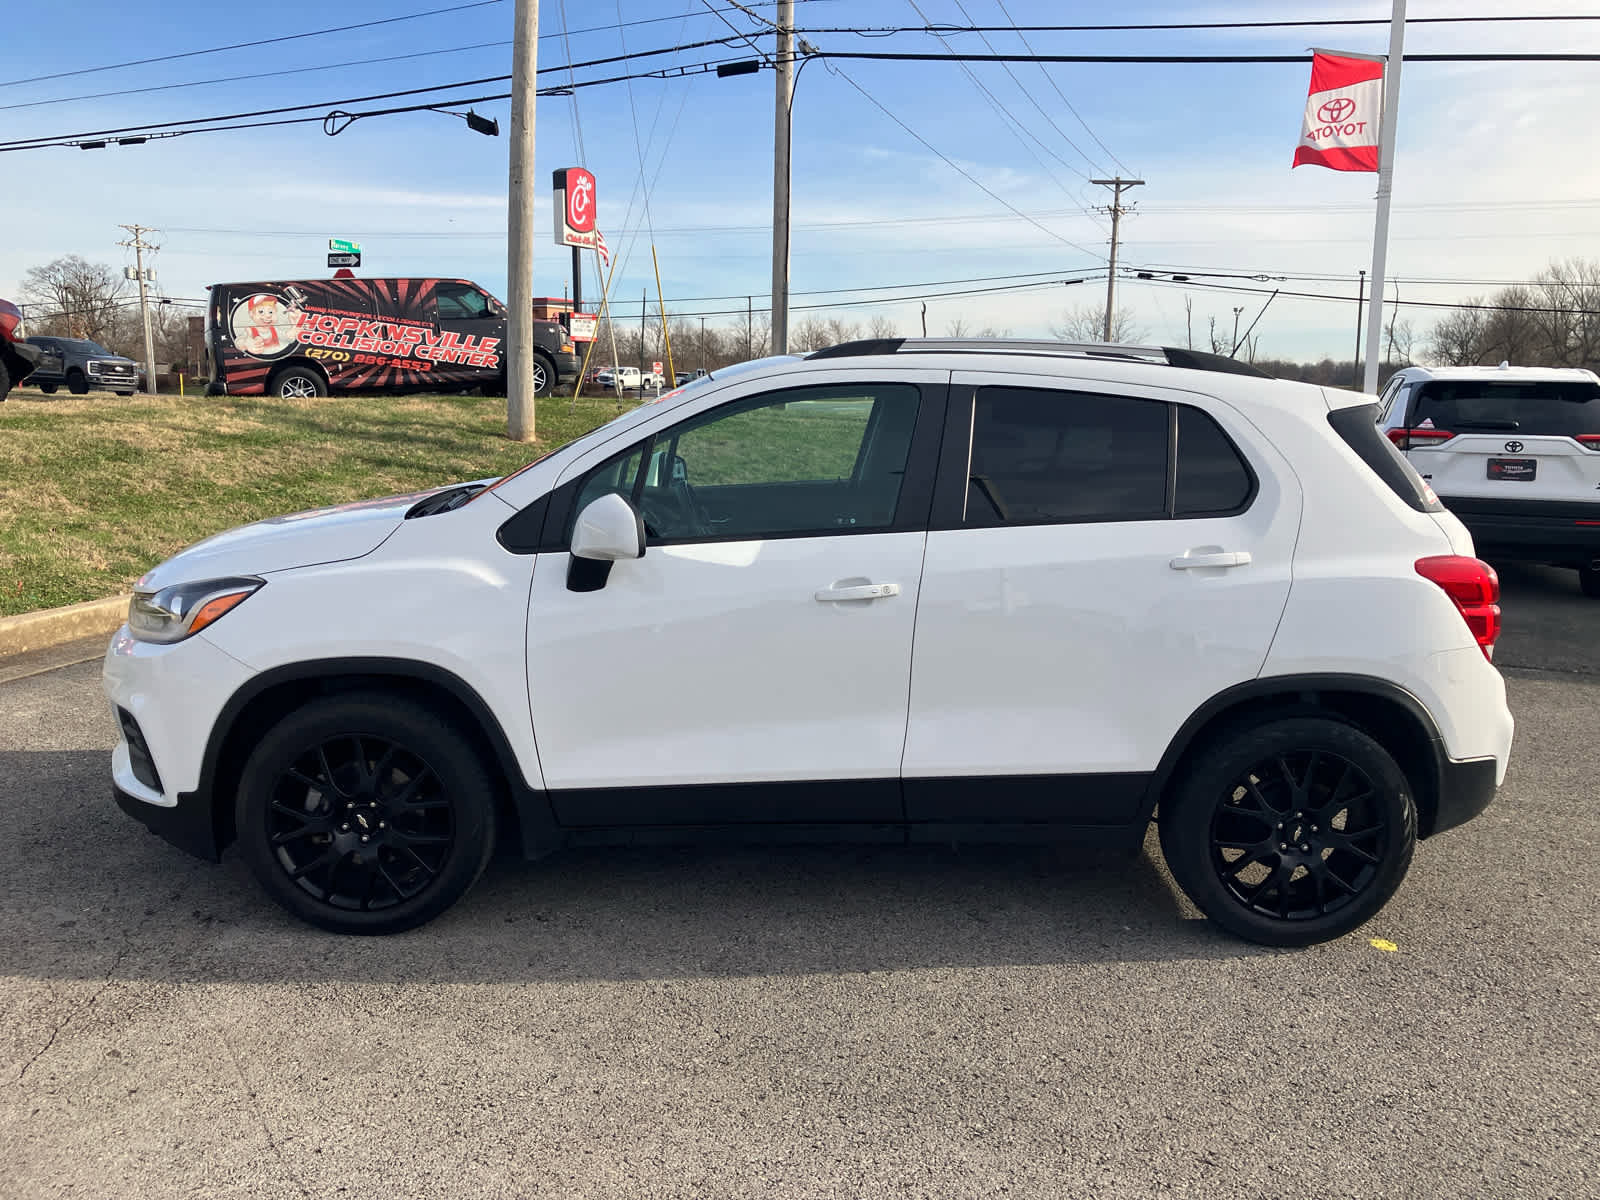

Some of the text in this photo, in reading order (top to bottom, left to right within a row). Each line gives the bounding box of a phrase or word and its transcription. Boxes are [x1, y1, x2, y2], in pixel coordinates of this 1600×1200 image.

[296, 313, 500, 354] HOPKINSVILLE
[297, 331, 499, 369] COLLISION CENTER
[304, 347, 351, 362] (270)
